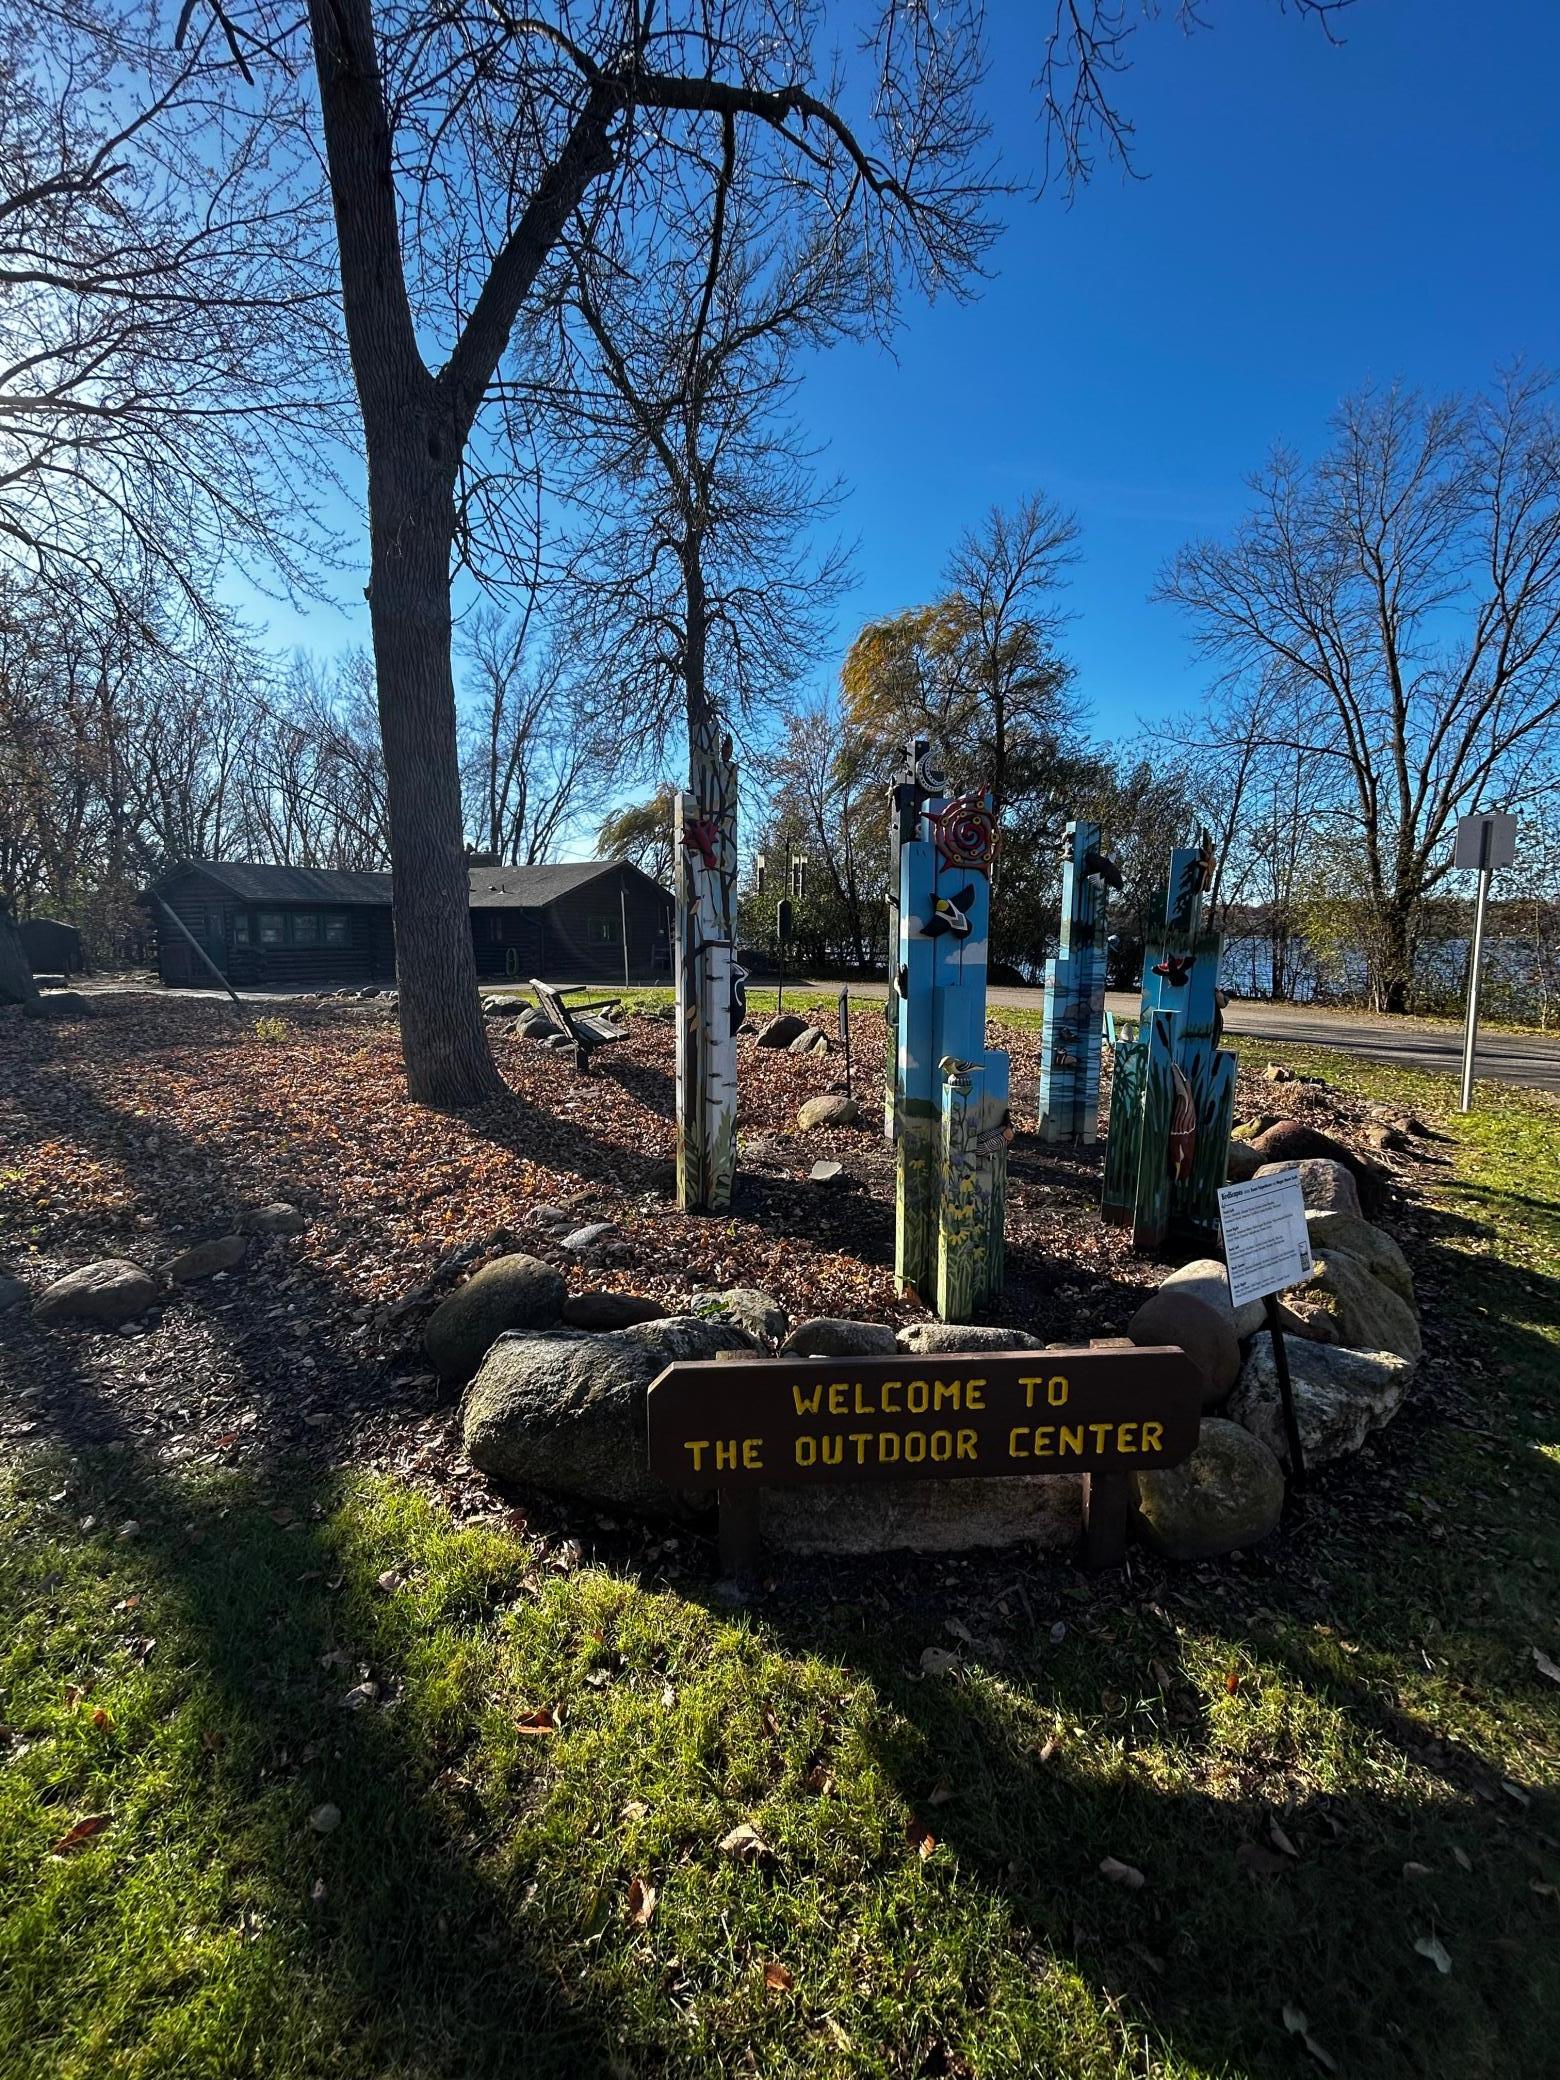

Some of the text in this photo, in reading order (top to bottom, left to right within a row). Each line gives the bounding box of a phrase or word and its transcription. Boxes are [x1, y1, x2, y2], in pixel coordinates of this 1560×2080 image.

[791, 1376, 1069, 1416] WELCOME TO
[684, 1421, 1164, 1472] THE OUTDOOR CENTER
